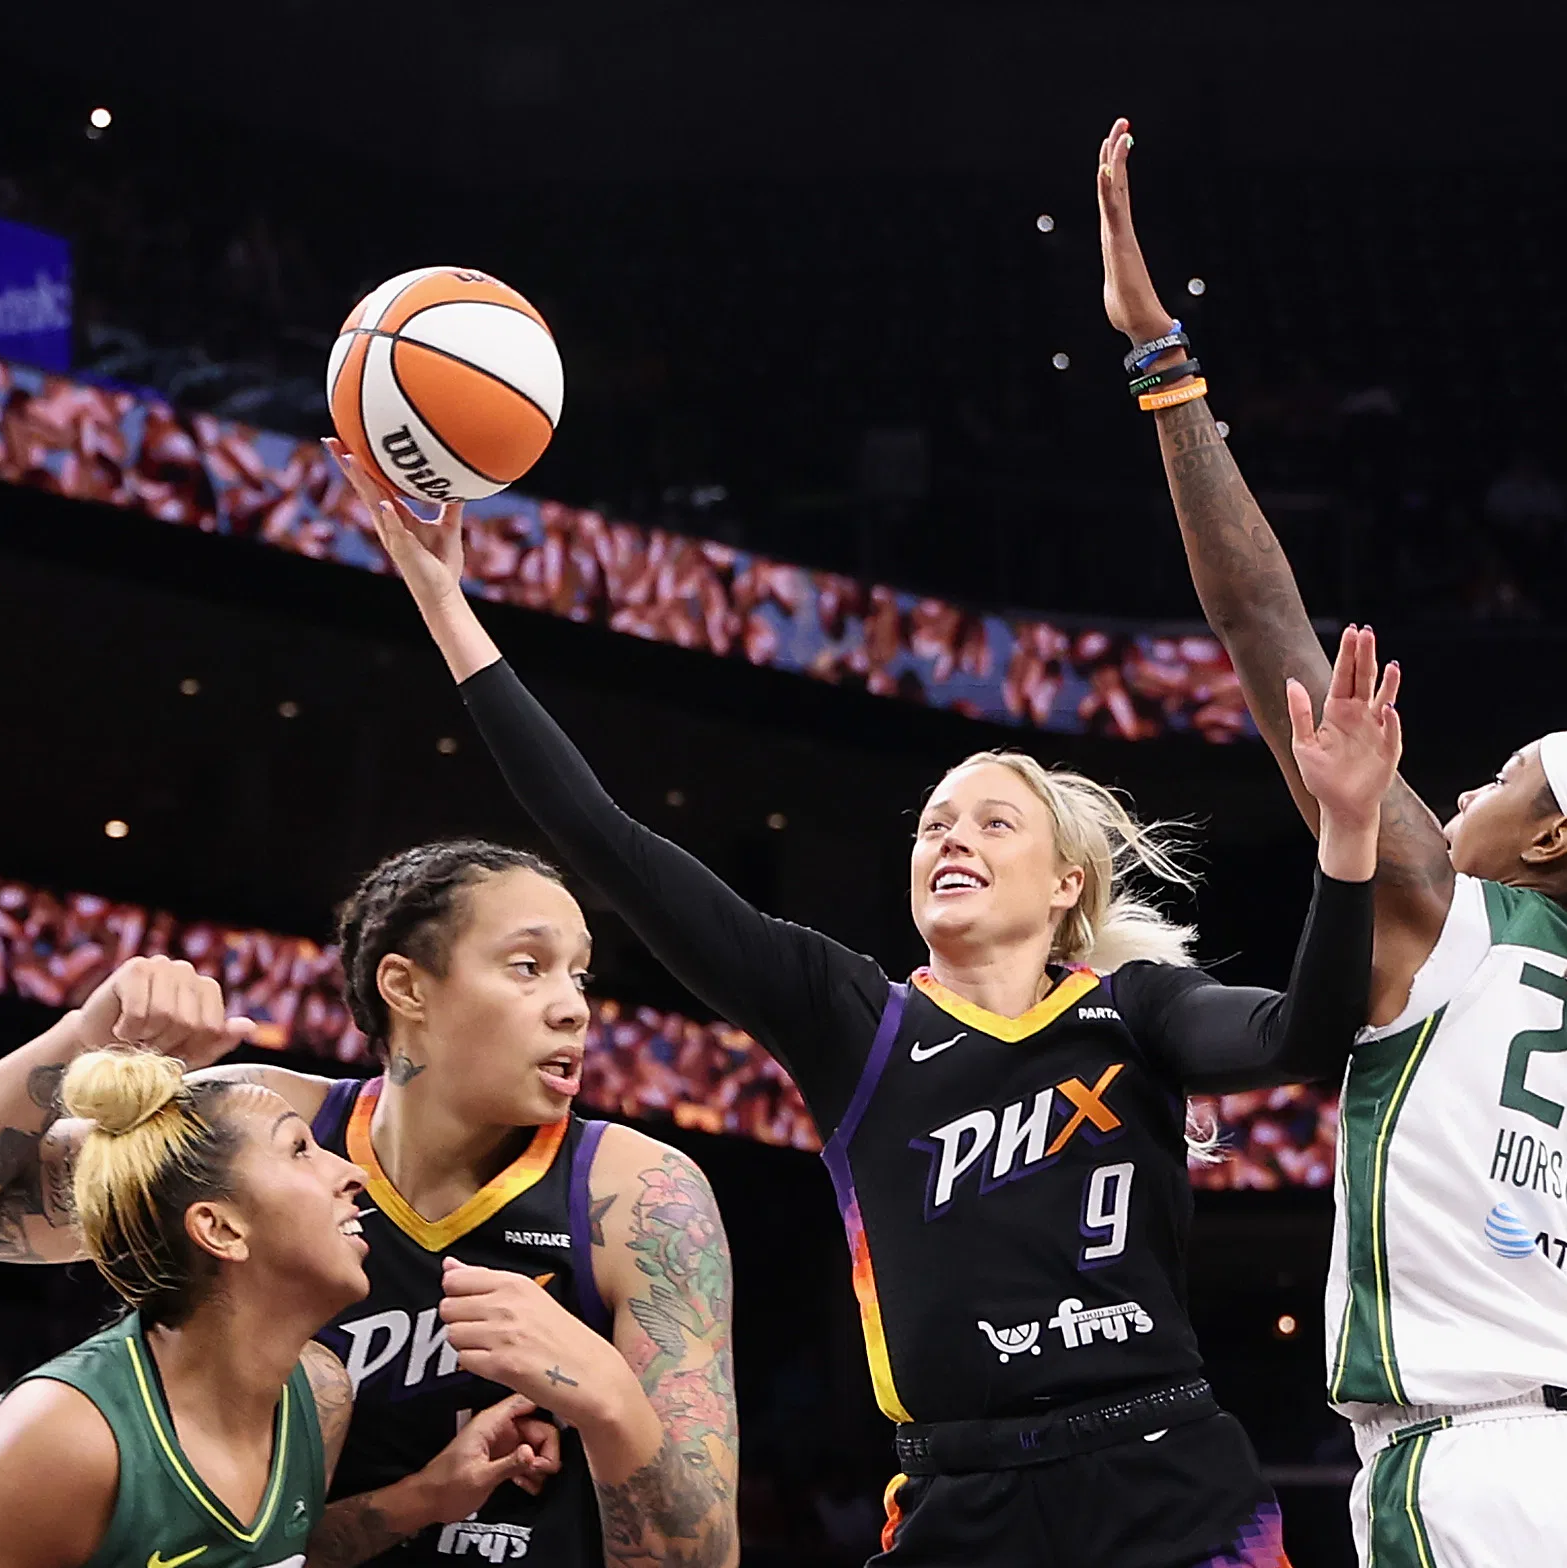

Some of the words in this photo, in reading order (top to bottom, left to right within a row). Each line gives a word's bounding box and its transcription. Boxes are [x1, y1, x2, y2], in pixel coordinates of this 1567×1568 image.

[926, 1063, 1126, 1208] PHX
[504, 1230, 571, 1249] PARTAKE
[1083, 1161, 1135, 1262] 9
[1048, 1298, 1153, 1349] fry's
